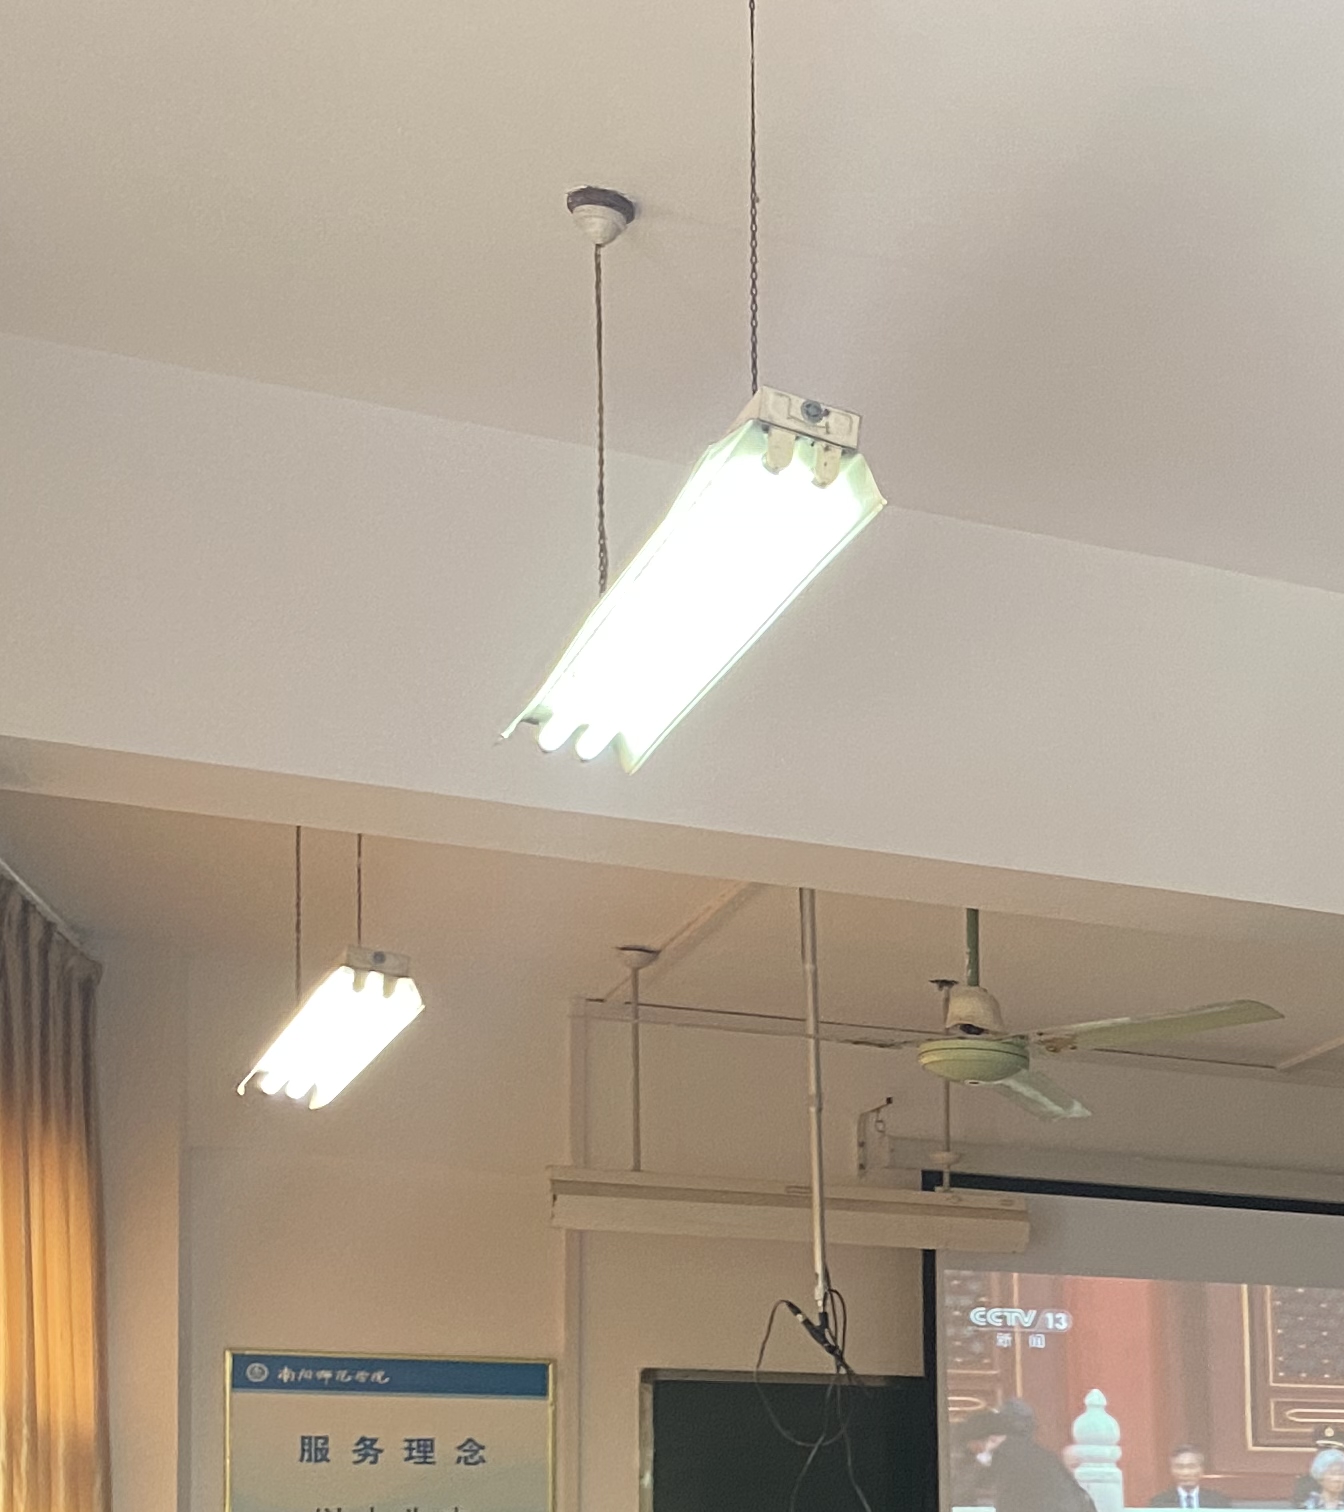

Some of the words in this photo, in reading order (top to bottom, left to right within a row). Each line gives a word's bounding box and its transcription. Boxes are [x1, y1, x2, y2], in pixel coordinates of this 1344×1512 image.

[969, 1306, 1037, 1328] CCTV
[1045, 1312, 1069, 1330] 13
[298, 1434, 487, 1466] 服务理念
